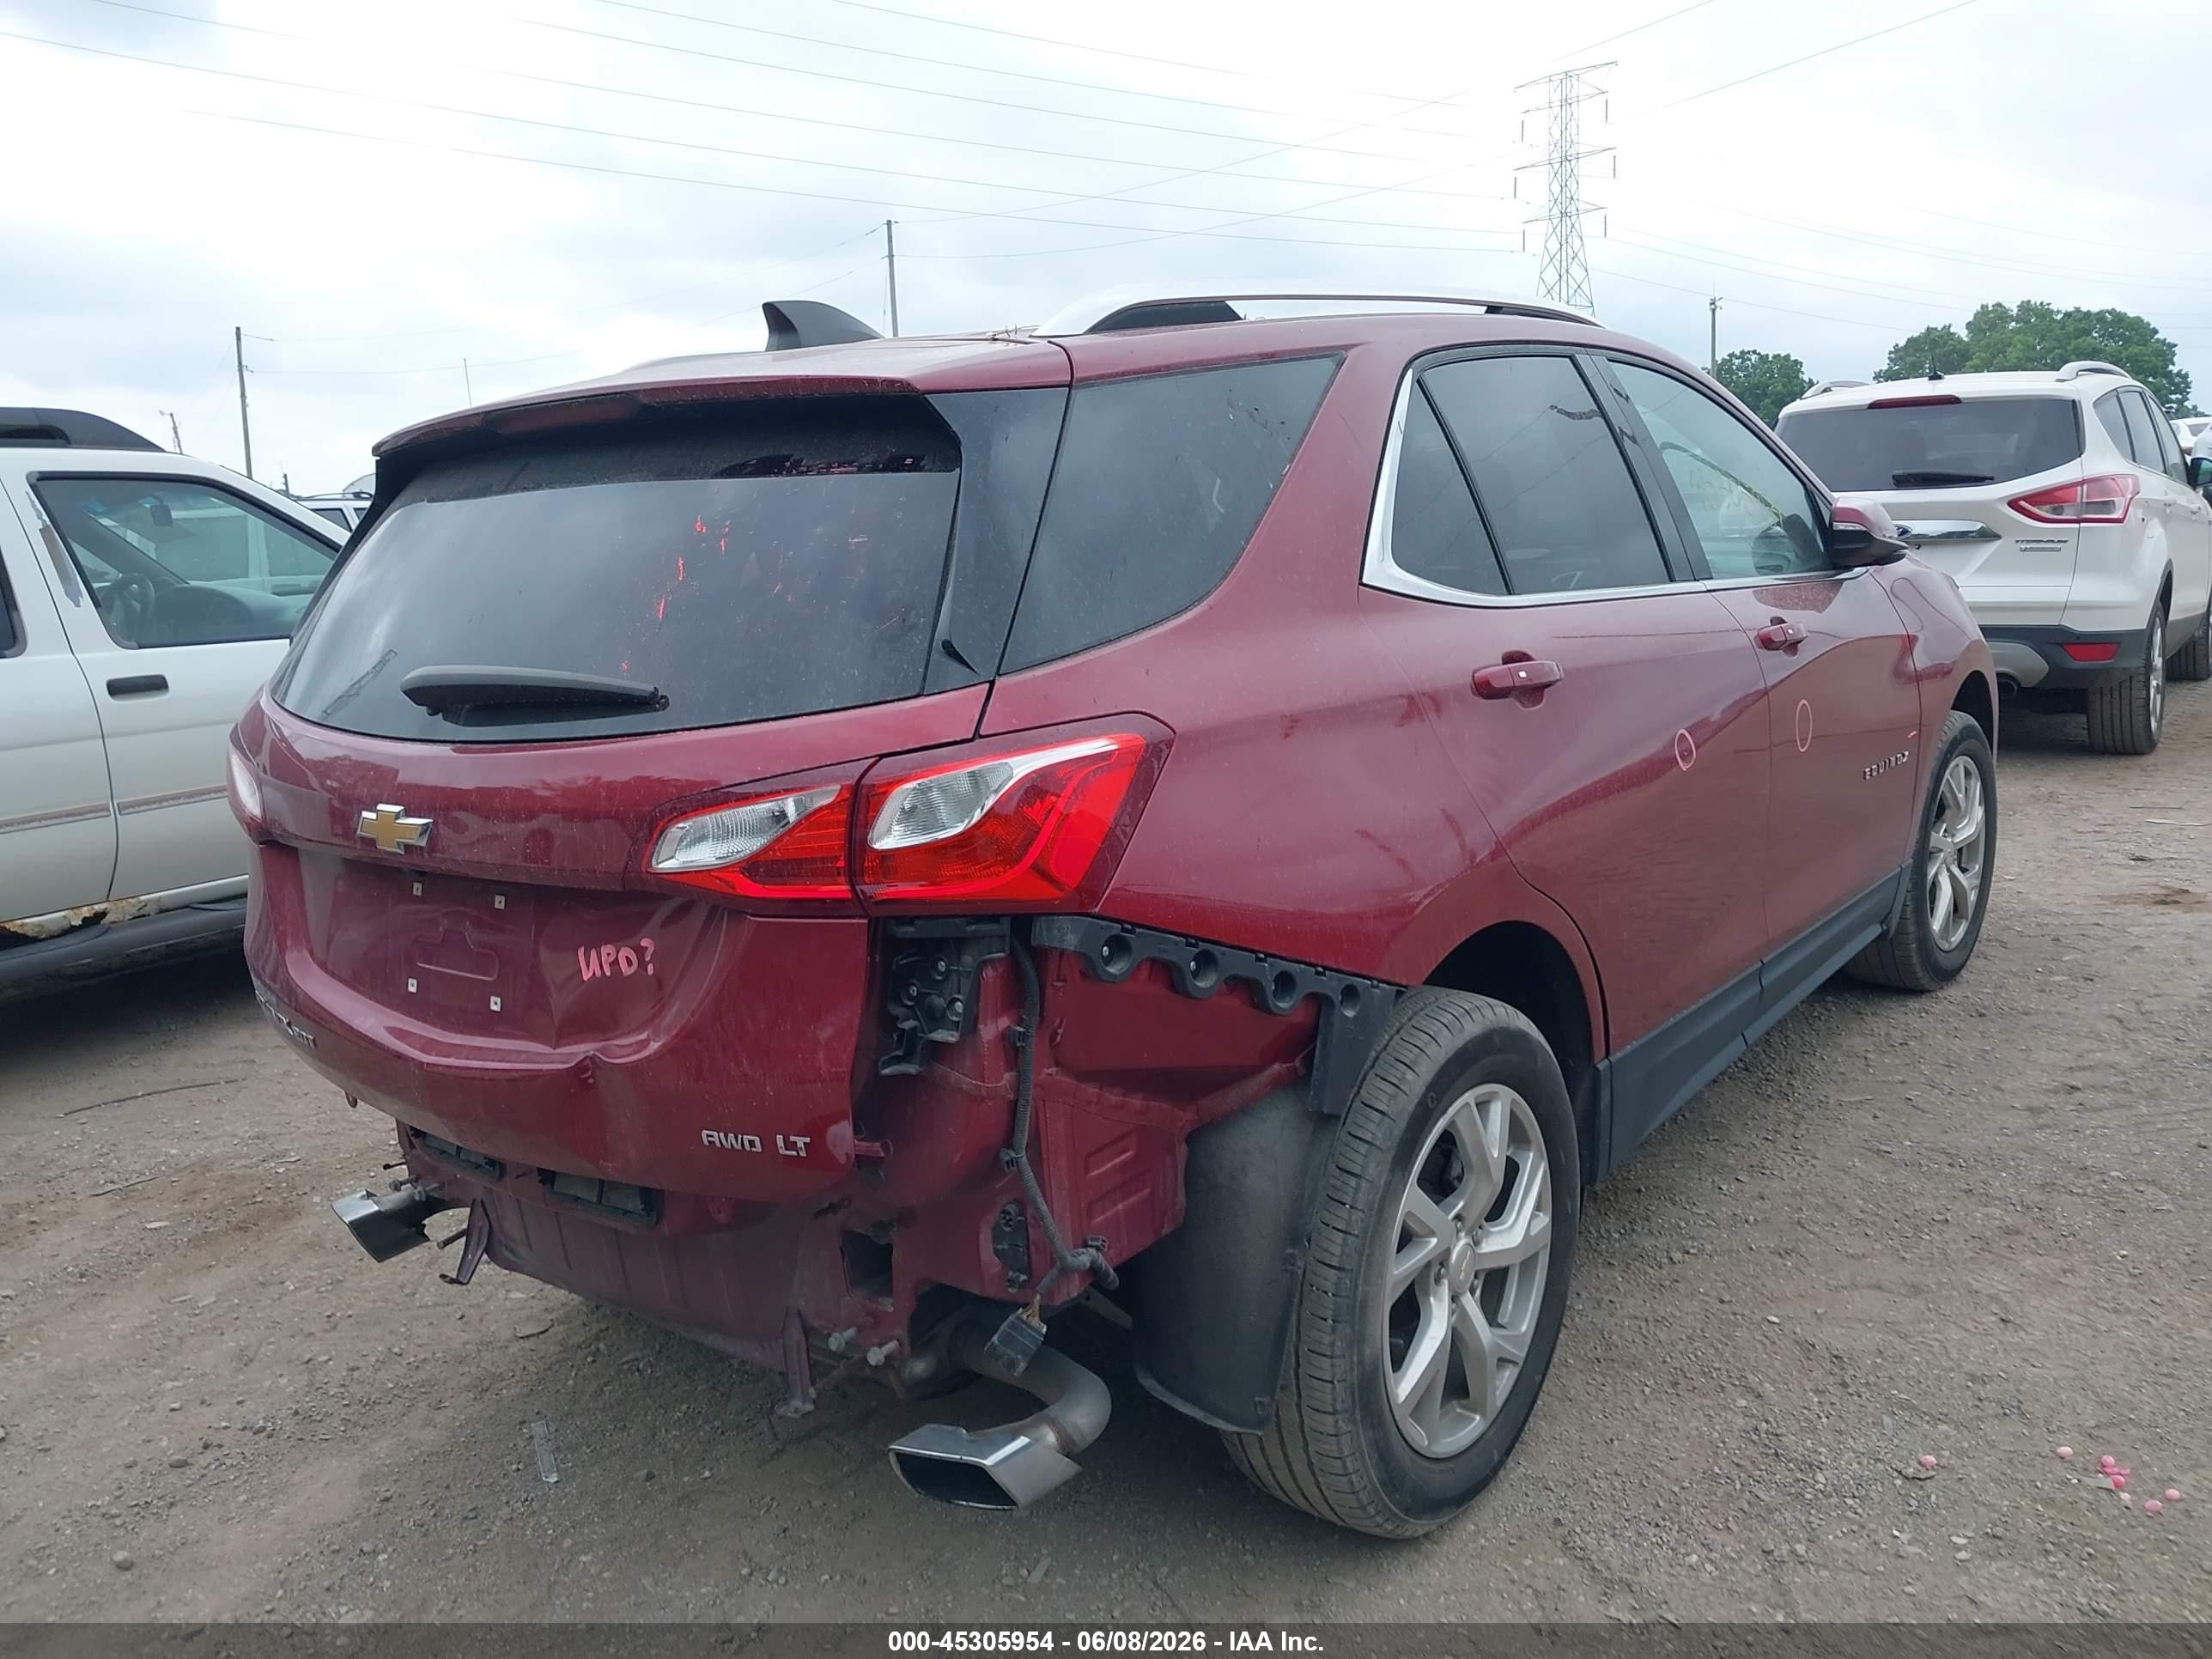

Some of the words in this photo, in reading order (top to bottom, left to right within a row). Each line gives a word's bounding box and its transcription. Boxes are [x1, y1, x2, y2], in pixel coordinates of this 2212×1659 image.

[578, 939, 654, 981] UPD?
[701, 1129, 763, 1153] AWD
[775, 1133, 811, 1158] LT
